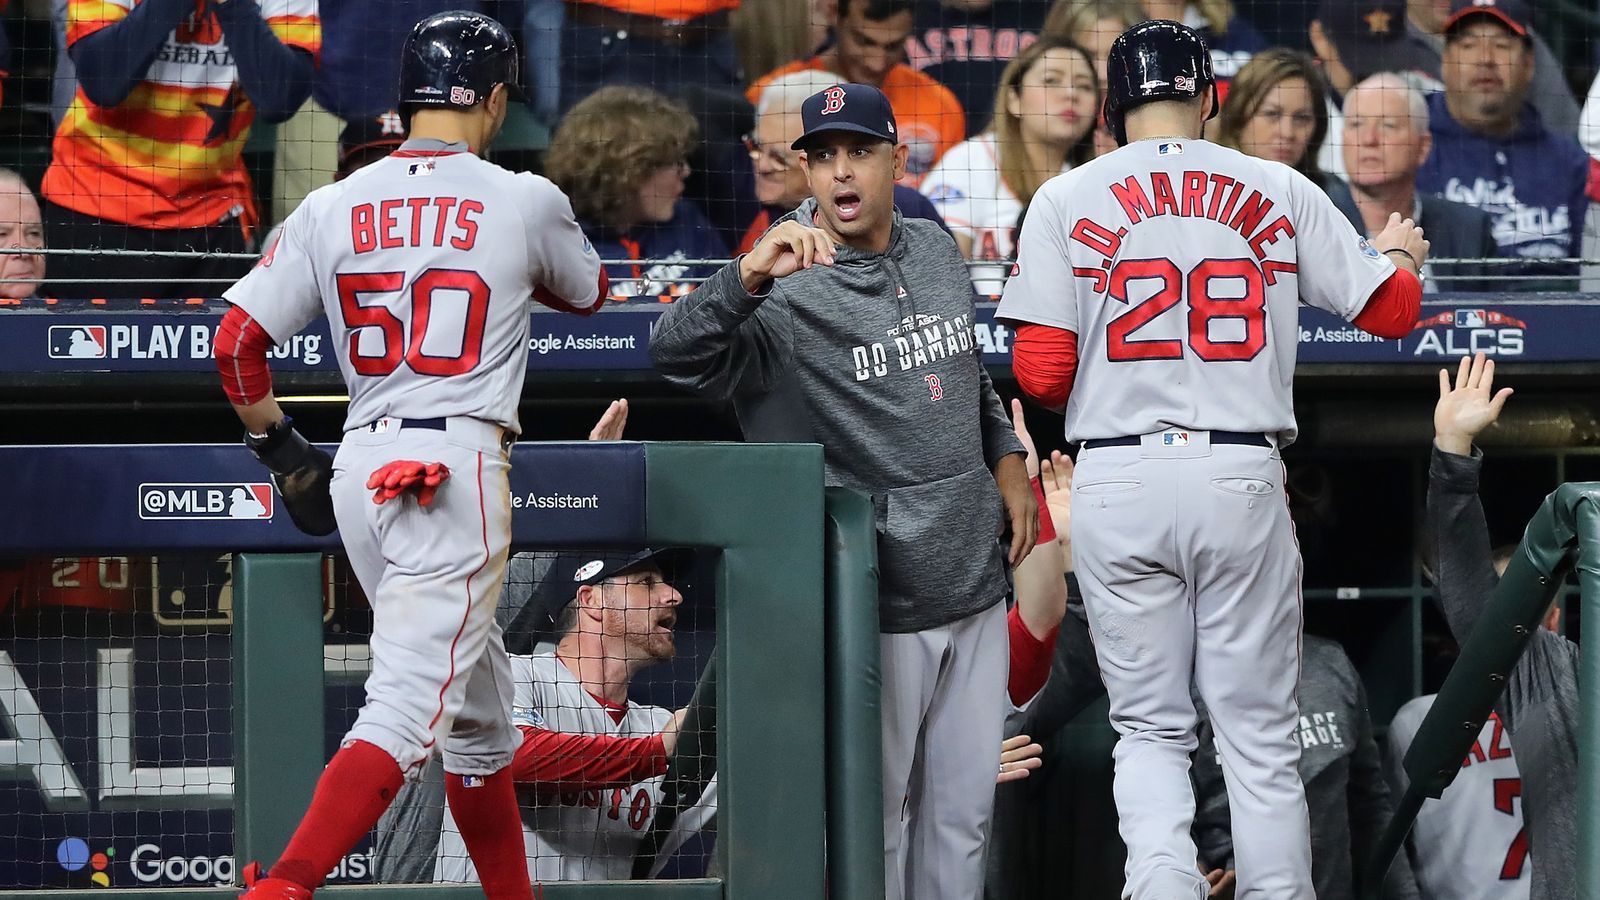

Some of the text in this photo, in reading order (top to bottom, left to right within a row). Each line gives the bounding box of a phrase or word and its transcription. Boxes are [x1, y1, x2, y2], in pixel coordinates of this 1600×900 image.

[450, 86, 475, 106] 50
[821, 86, 847, 115] B
[351, 197, 485, 255] BETTS
[1069, 217, 1129, 294] J.D.
[335, 267, 492, 377] 50
[1106, 257, 1267, 362] 28
[111, 325, 185, 359] PLAY
[564, 333, 636, 350] Assistant
[975, 323, 1009, 354] At
[1413, 328, 1524, 356] ALCS
[852, 342, 888, 381] DO
[924, 374, 943, 401] B
[143, 489, 226, 513] @MLB
[525, 492, 599, 509] Assistant
[1293, 711, 1343, 749] AGE
